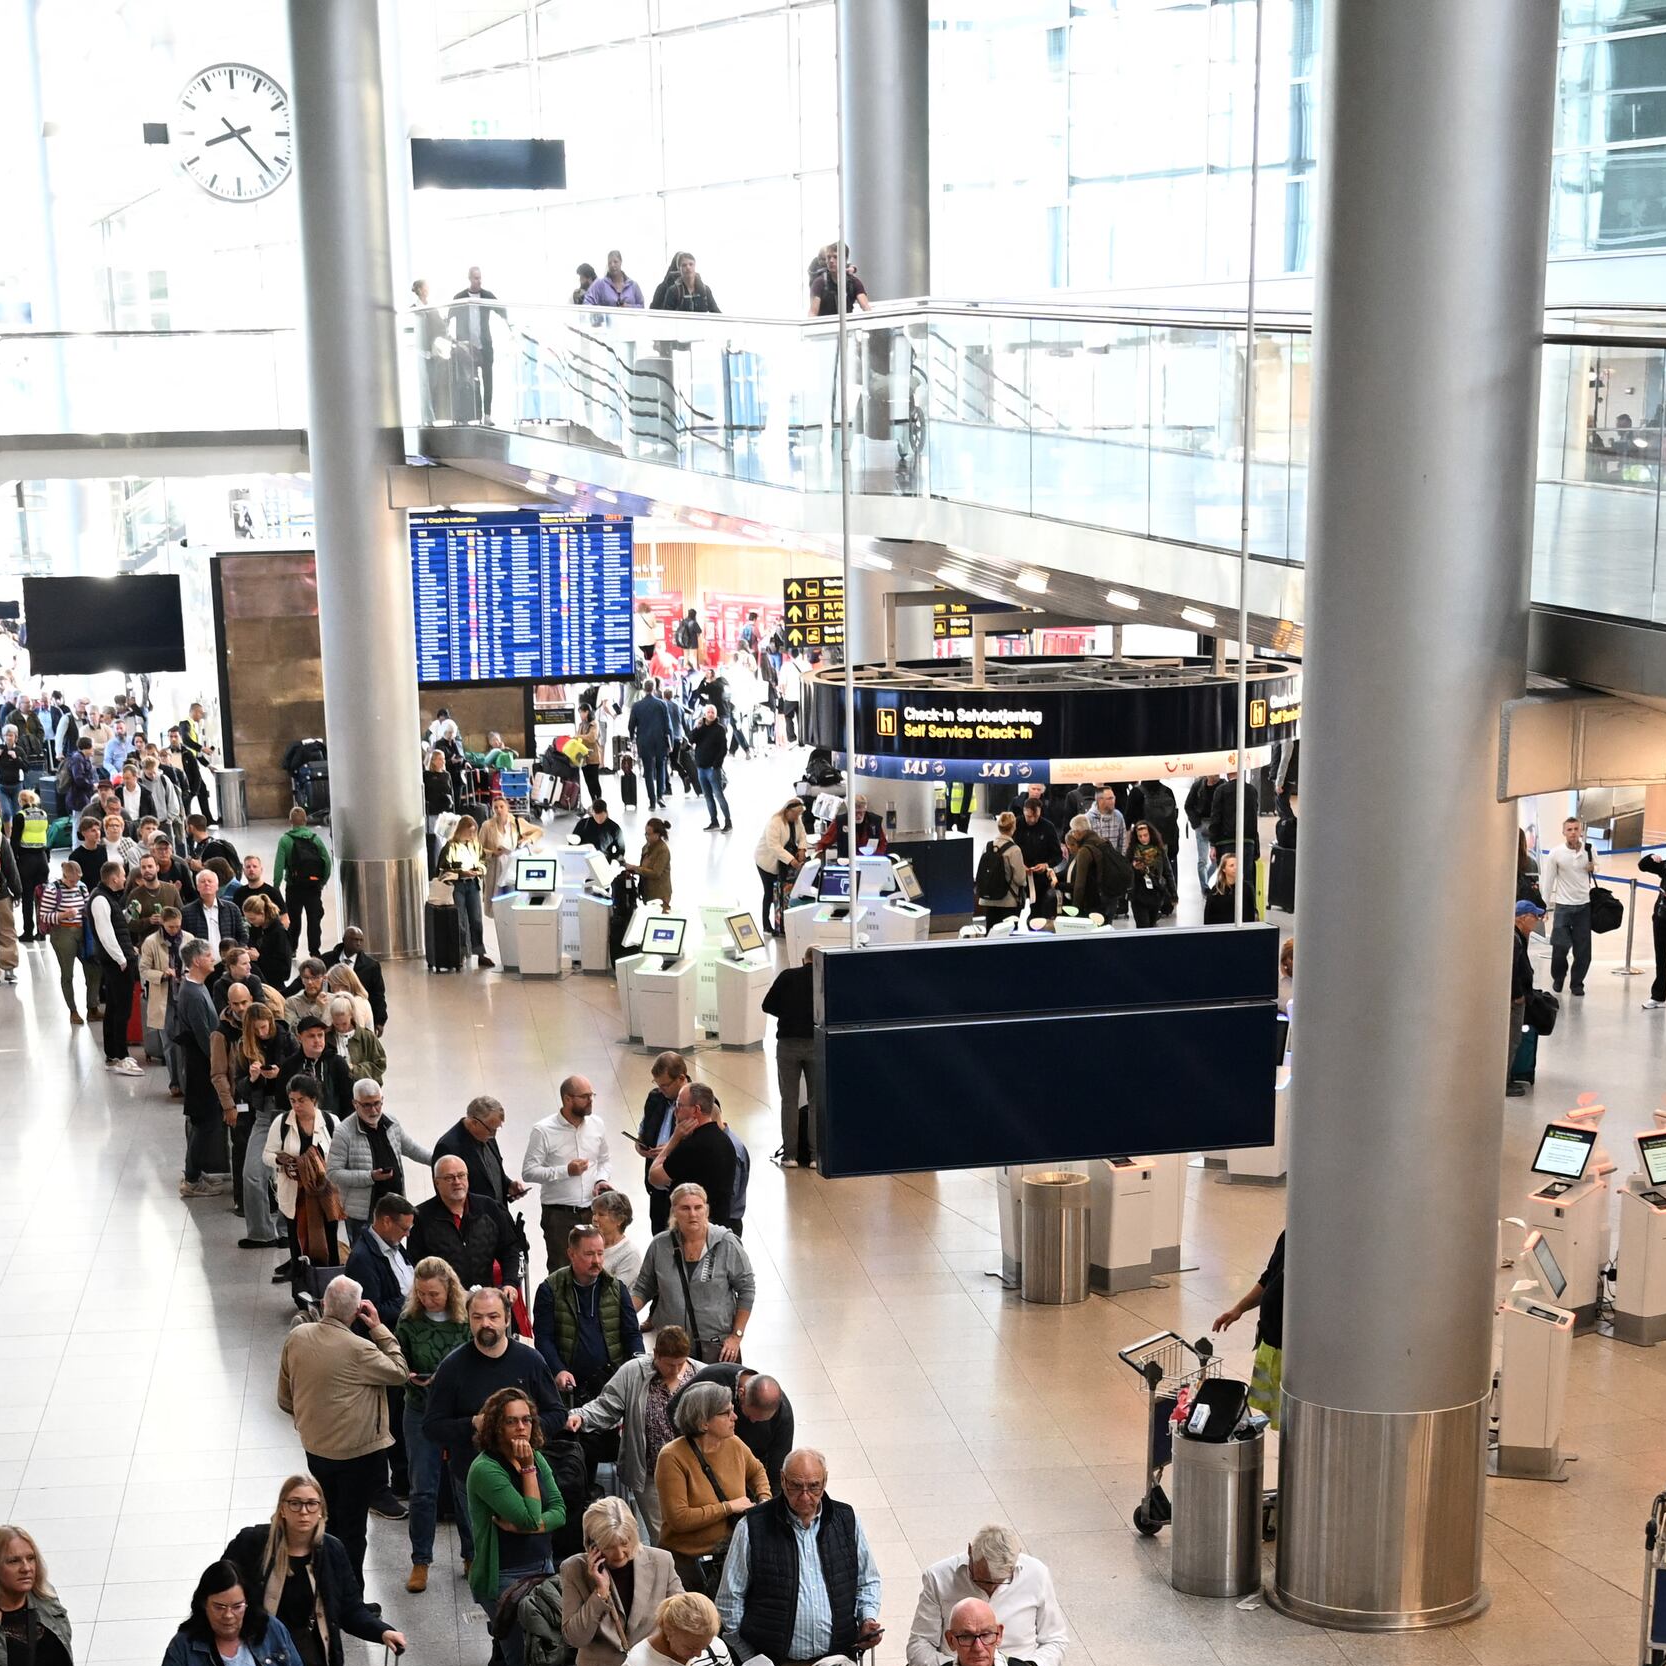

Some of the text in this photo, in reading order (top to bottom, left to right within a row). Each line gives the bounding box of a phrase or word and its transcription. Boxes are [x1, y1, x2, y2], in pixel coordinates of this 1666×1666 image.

[950, 604, 968, 613] Train
[950, 618, 970, 627] Metro
[950, 627, 970, 636] Metro
[956, 707, 1043, 725] Selvbetjening
[904, 723, 927, 738] Self
[927, 724, 973, 739] Service
[901, 759, 930, 776] SAS
[978, 761, 1014, 778] SAS
[1059, 761, 1124, 773] SUNCLASS
[1182, 763, 1194, 772] TUI
